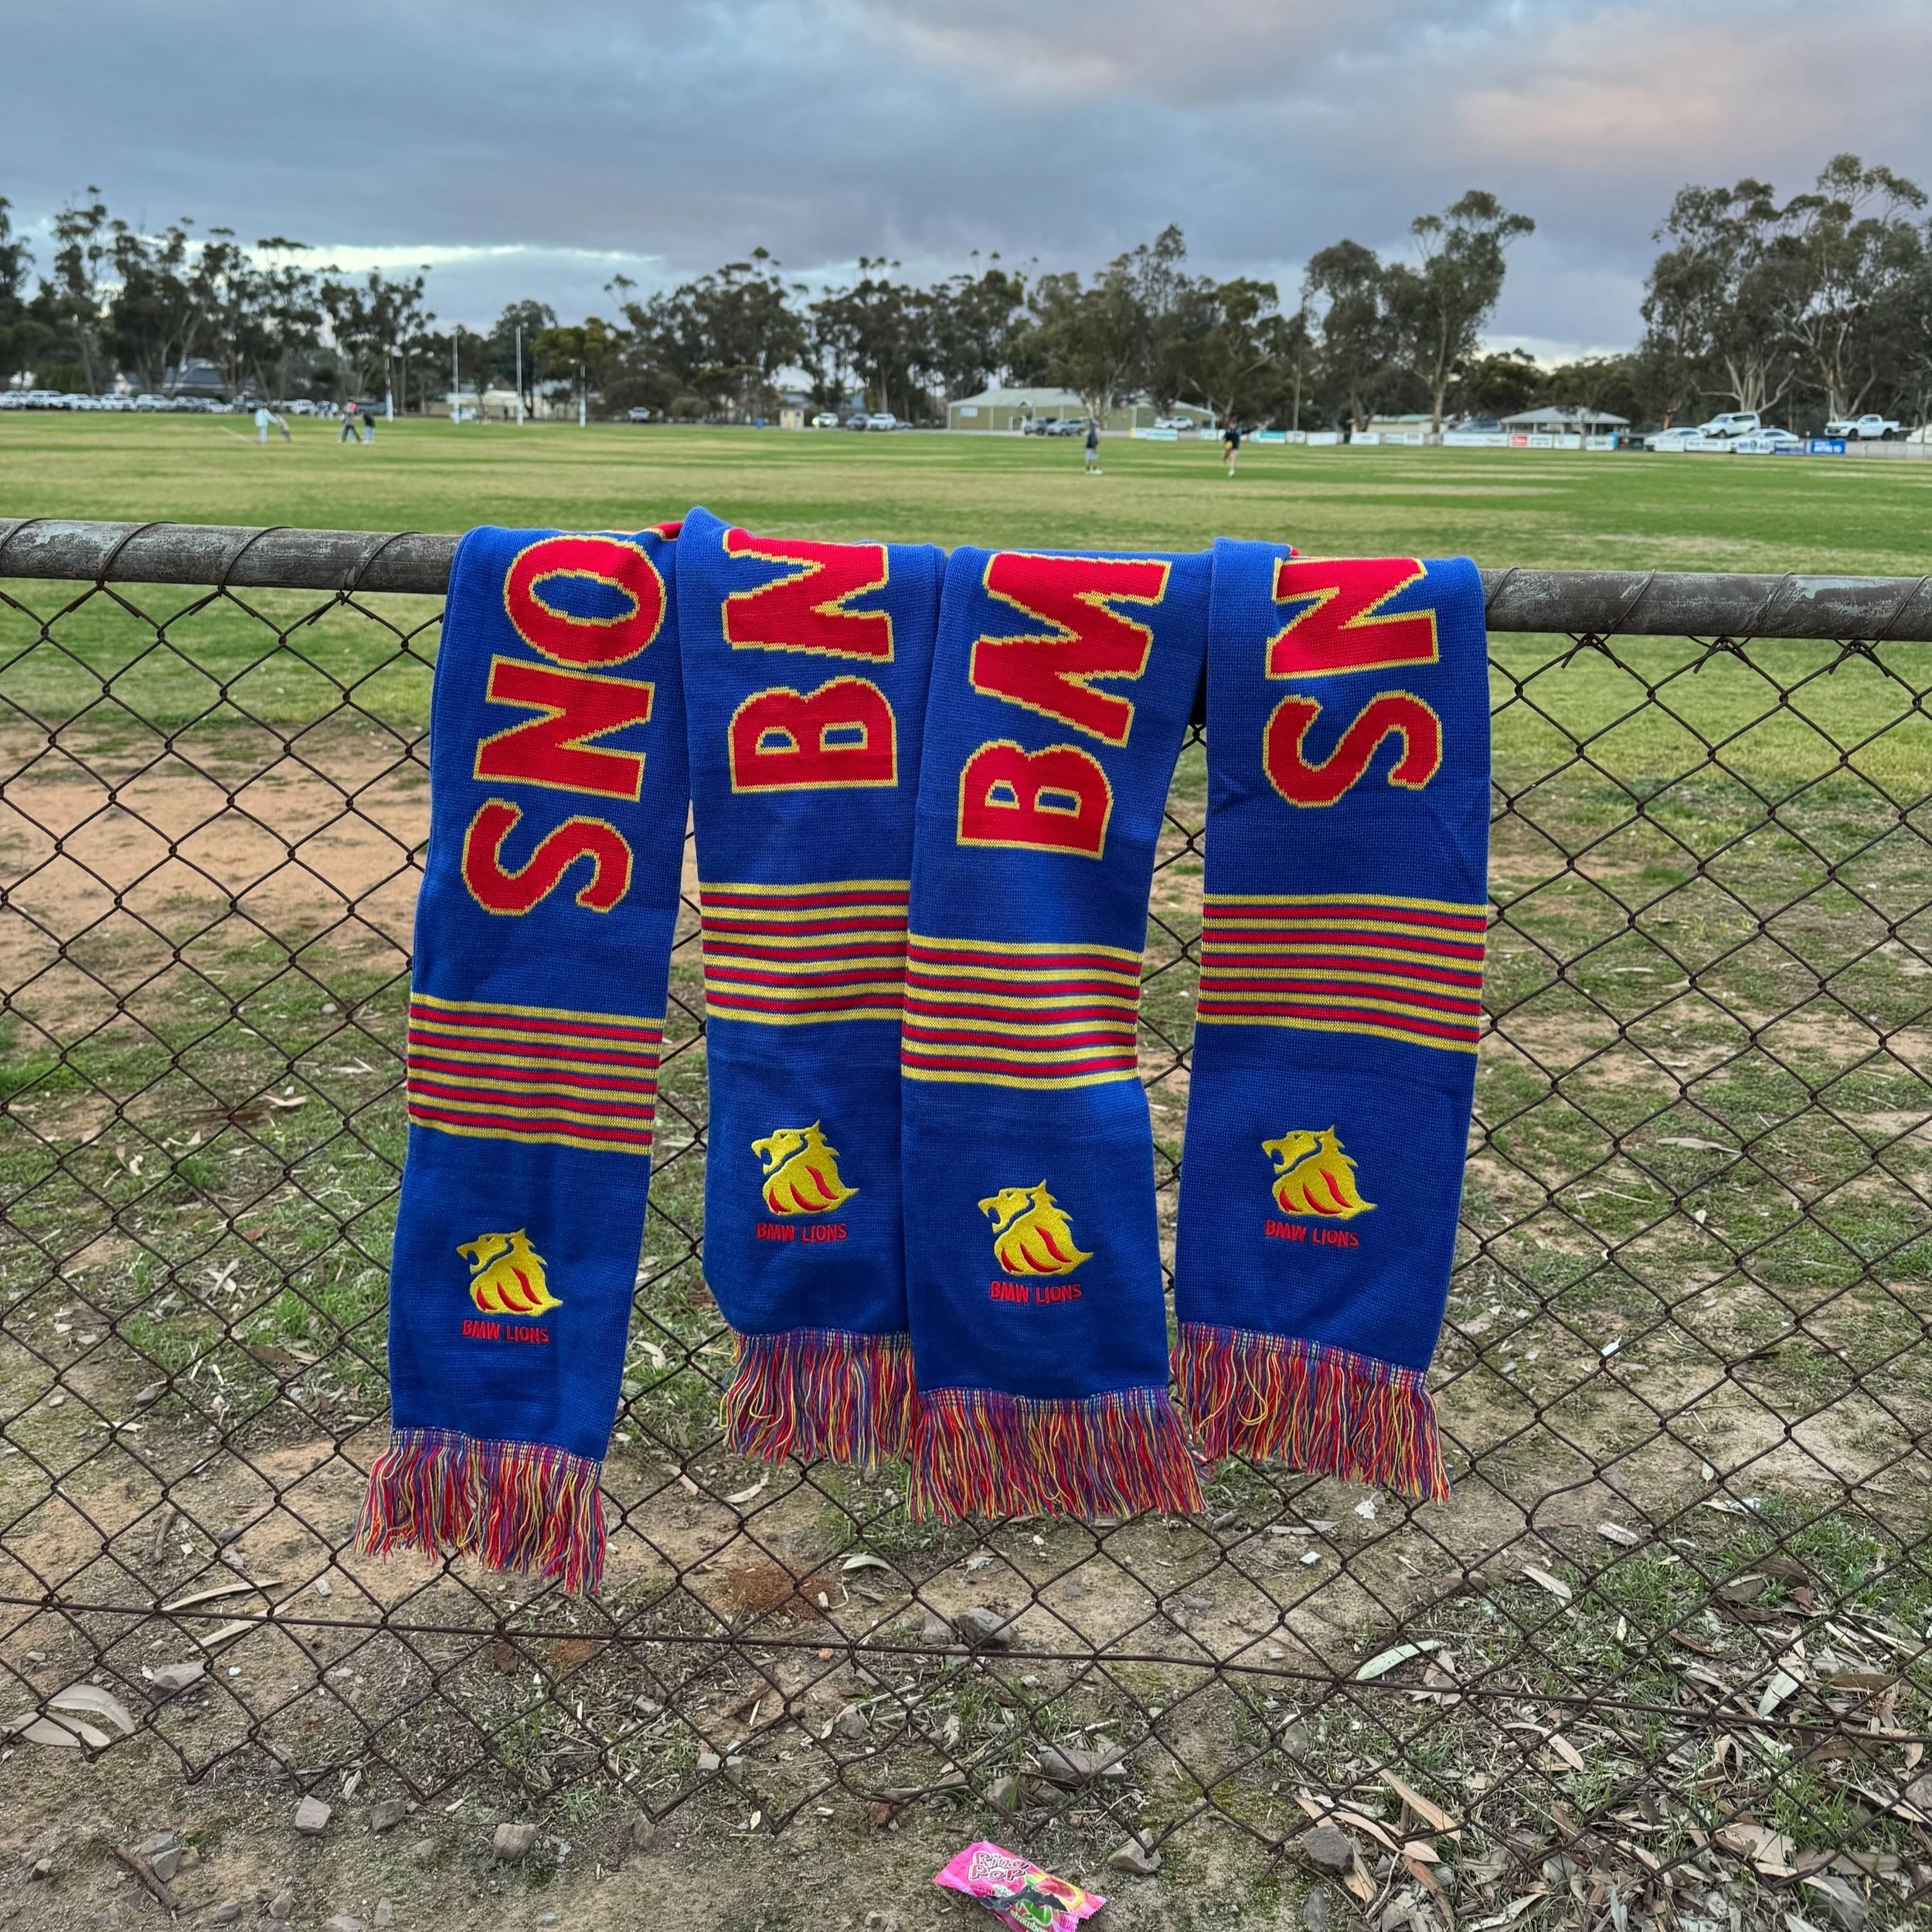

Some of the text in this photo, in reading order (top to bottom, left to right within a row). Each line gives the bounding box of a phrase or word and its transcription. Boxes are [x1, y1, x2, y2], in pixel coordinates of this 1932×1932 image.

[756, 1223, 848, 1243] BMW LIONS
[1265, 1219, 1359, 1248] BMW LIONS
[990, 1281, 1082, 1304] BMW LIONS
[462, 1319, 549, 1344] BMW LIONS
[973, 1851, 1030, 1869] Ring
